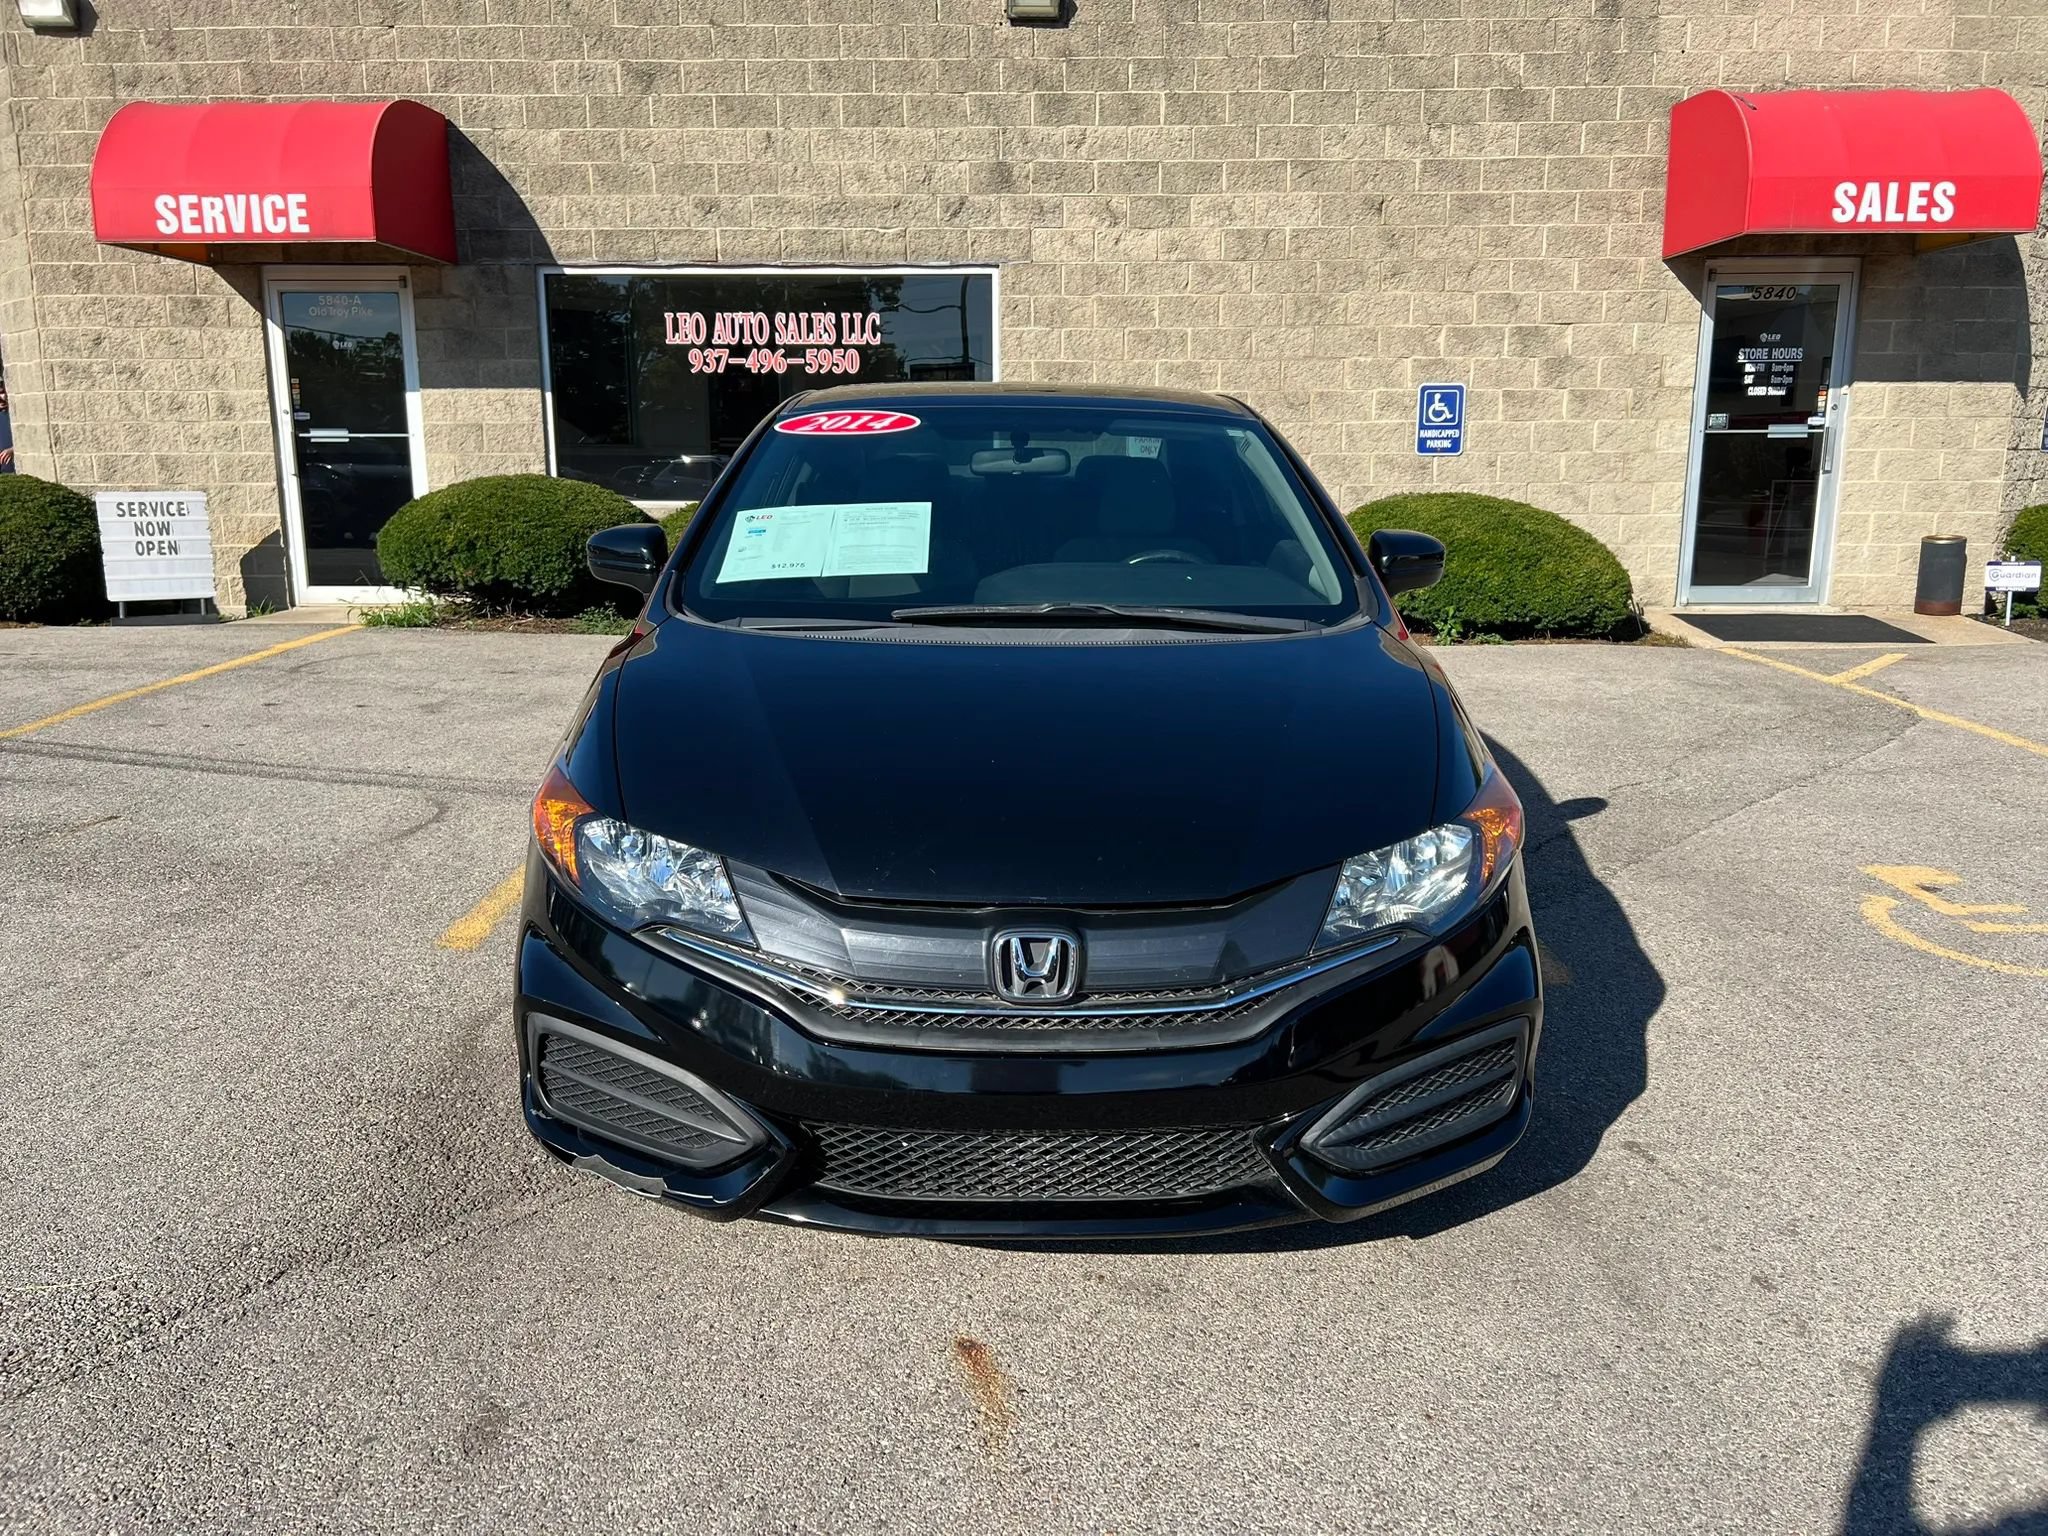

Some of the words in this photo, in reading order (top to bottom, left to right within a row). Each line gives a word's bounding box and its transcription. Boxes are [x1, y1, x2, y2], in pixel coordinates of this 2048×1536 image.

[1831, 181, 1957, 223] SALES
[154, 193, 311, 235] SERVICE
[318, 295, 361, 306] 5840-A
[1752, 286, 1797, 300] 5840
[309, 306, 328, 316] Old
[327, 306, 350, 319] Troy
[351, 306, 374, 317] Pike
[664, 312, 707, 345] LEO
[712, 312, 770, 345] AUTO
[775, 312, 836, 345] SALES
[841, 312, 881, 345] LLC
[688, 348, 860, 374] 937-496-5950
[1738, 347, 1769, 360] STORE
[1771, 347, 1803, 360] HOURS
[797, 415, 901, 432] 2014
[1419, 429, 1460, 438] HANDICAPPED
[1426, 439, 1452, 449] PARKING
[116, 501, 186, 517] SERVICE
[134, 521, 170, 537] NOW
[135, 540, 178, 556] OPEN
[1989, 568, 2037, 582] Guardian
